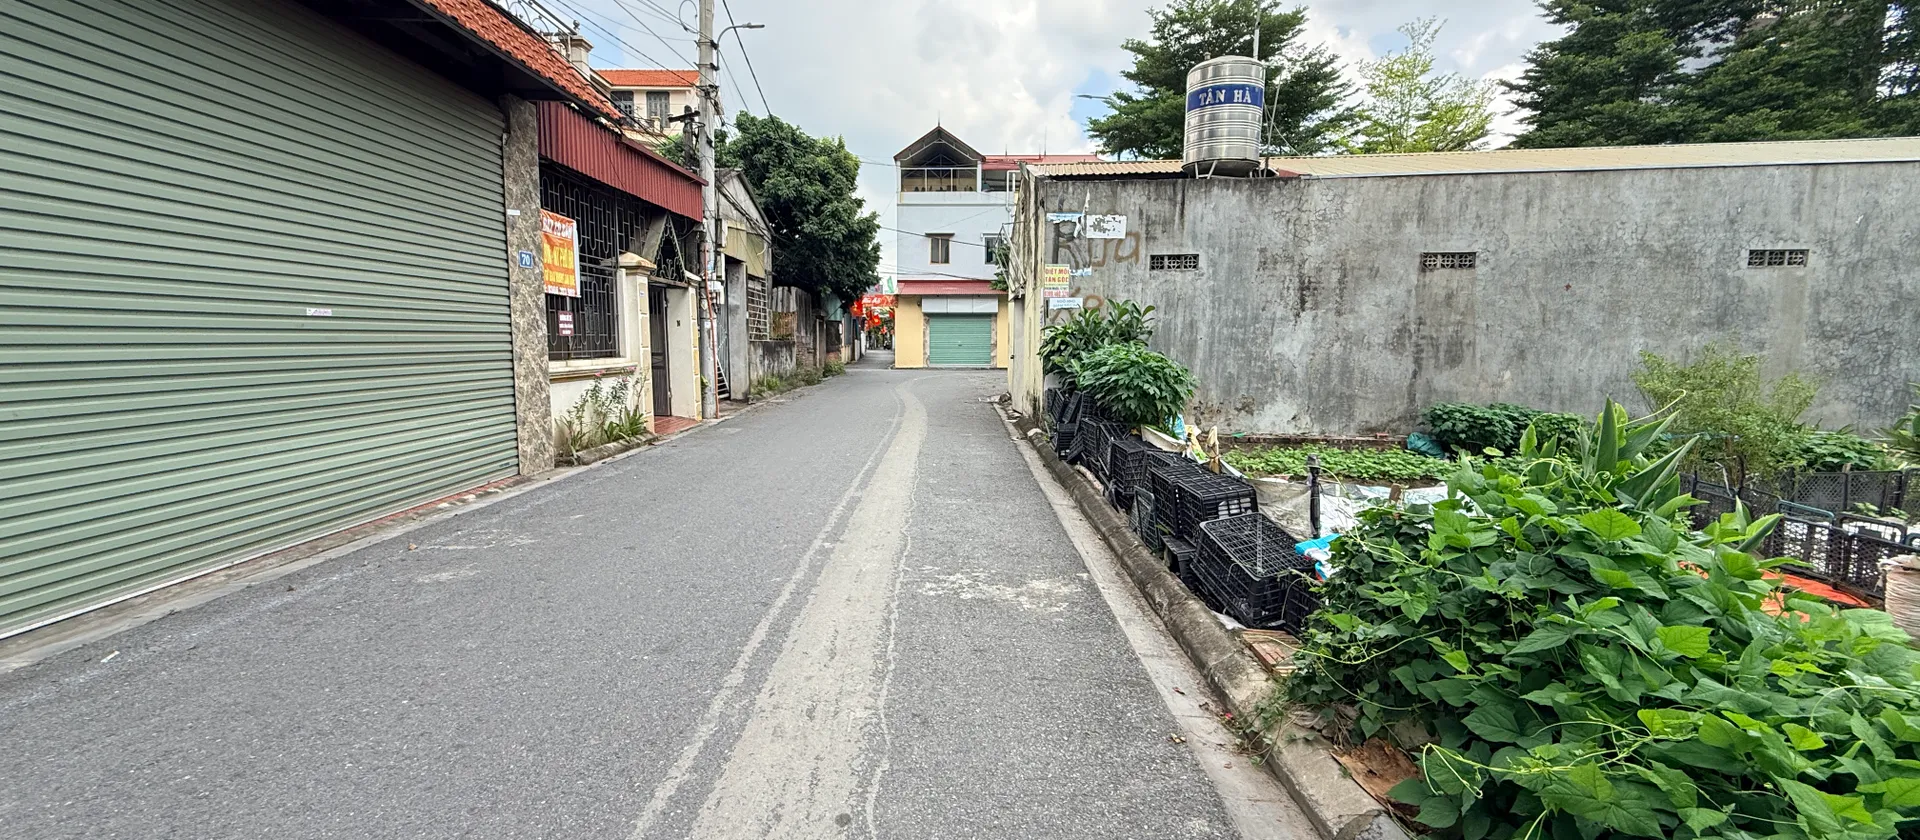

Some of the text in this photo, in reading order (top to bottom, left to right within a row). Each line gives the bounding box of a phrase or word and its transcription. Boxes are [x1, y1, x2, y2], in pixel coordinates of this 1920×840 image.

[1199, 86, 1252, 106] TÂN HÀ
[521, 253, 530, 265] 70
